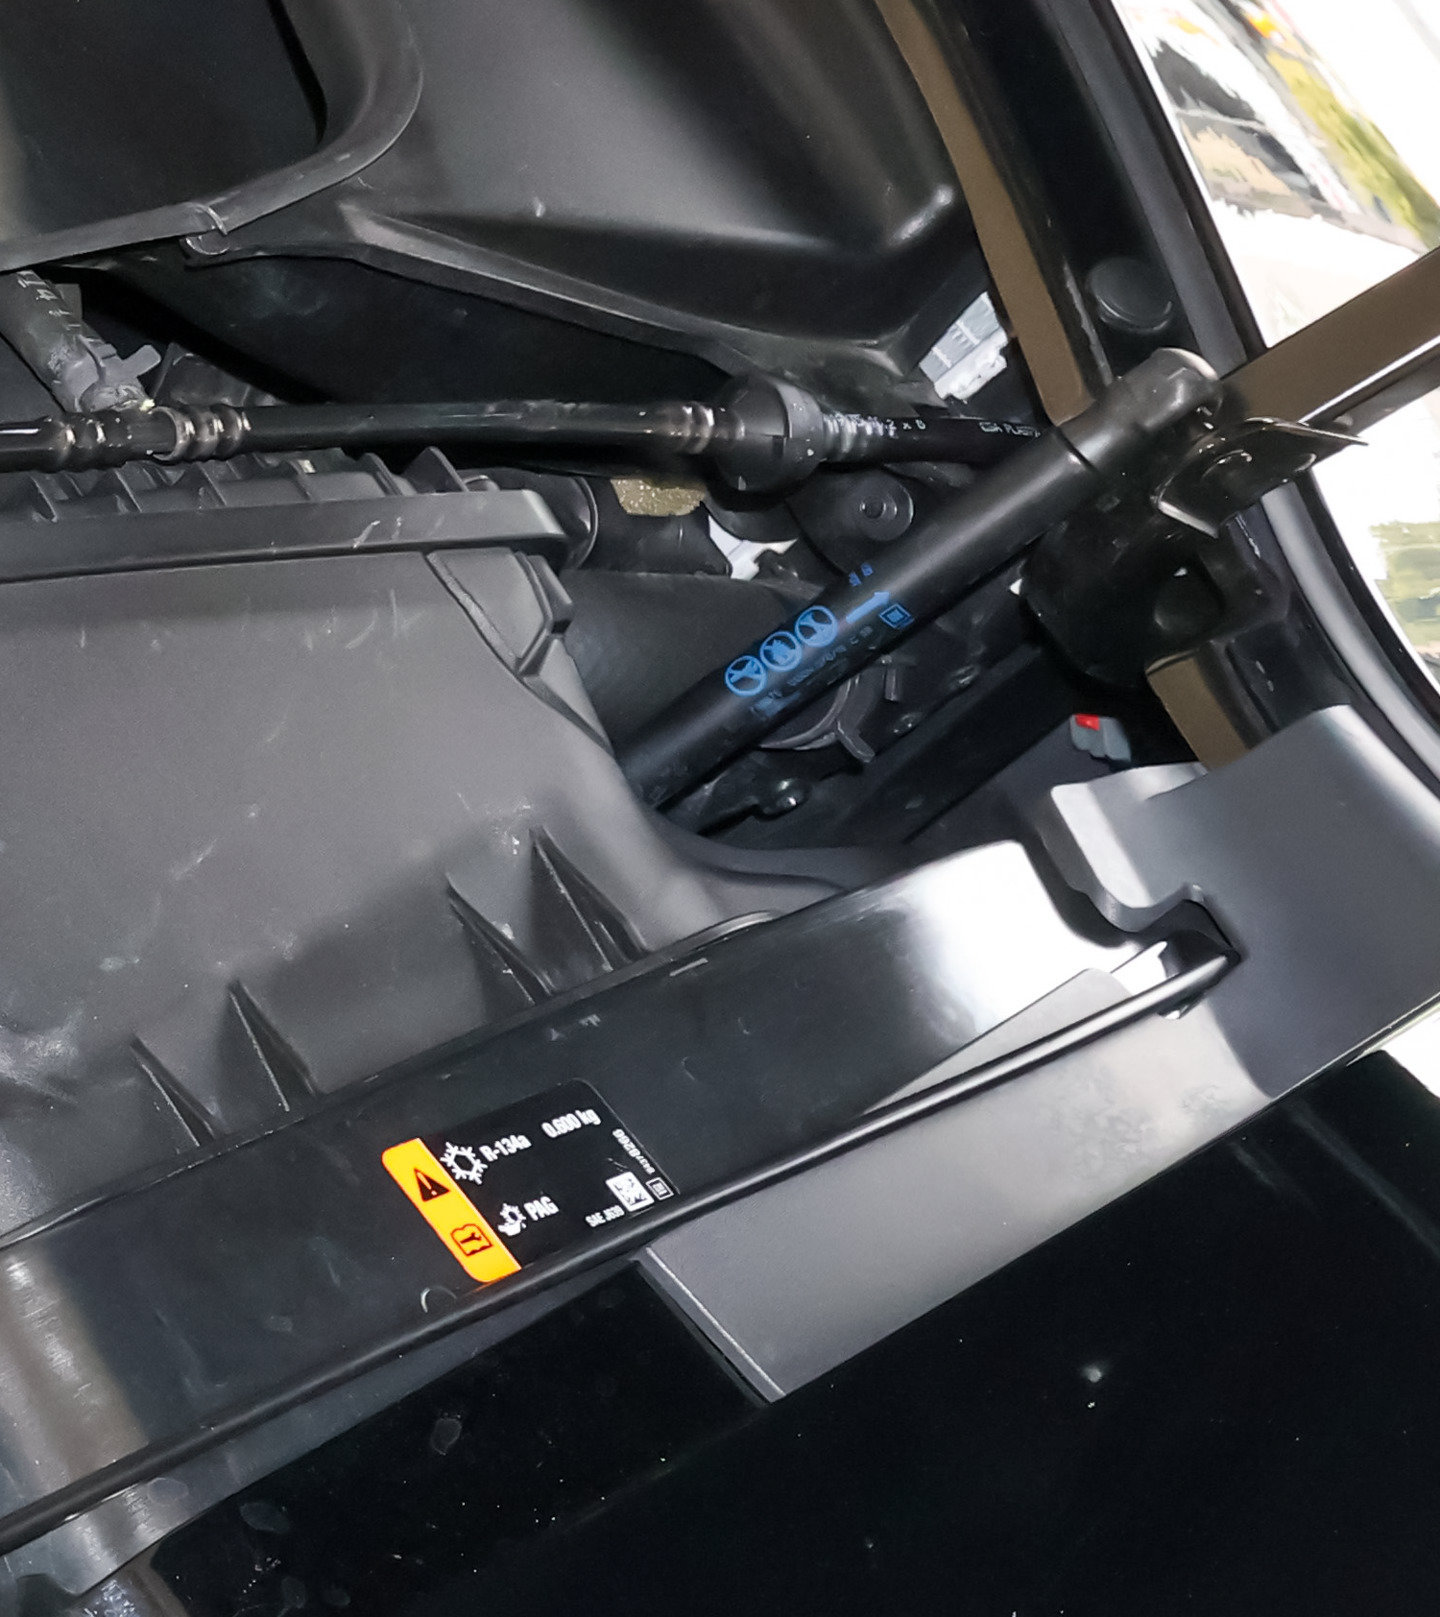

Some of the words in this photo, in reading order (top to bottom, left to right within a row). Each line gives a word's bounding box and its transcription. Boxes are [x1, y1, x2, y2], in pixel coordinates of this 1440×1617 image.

[478, 1134, 532, 1162] R-134a
[574, 1108, 602, 1126] kg
[523, 1195, 560, 1222] PAG
